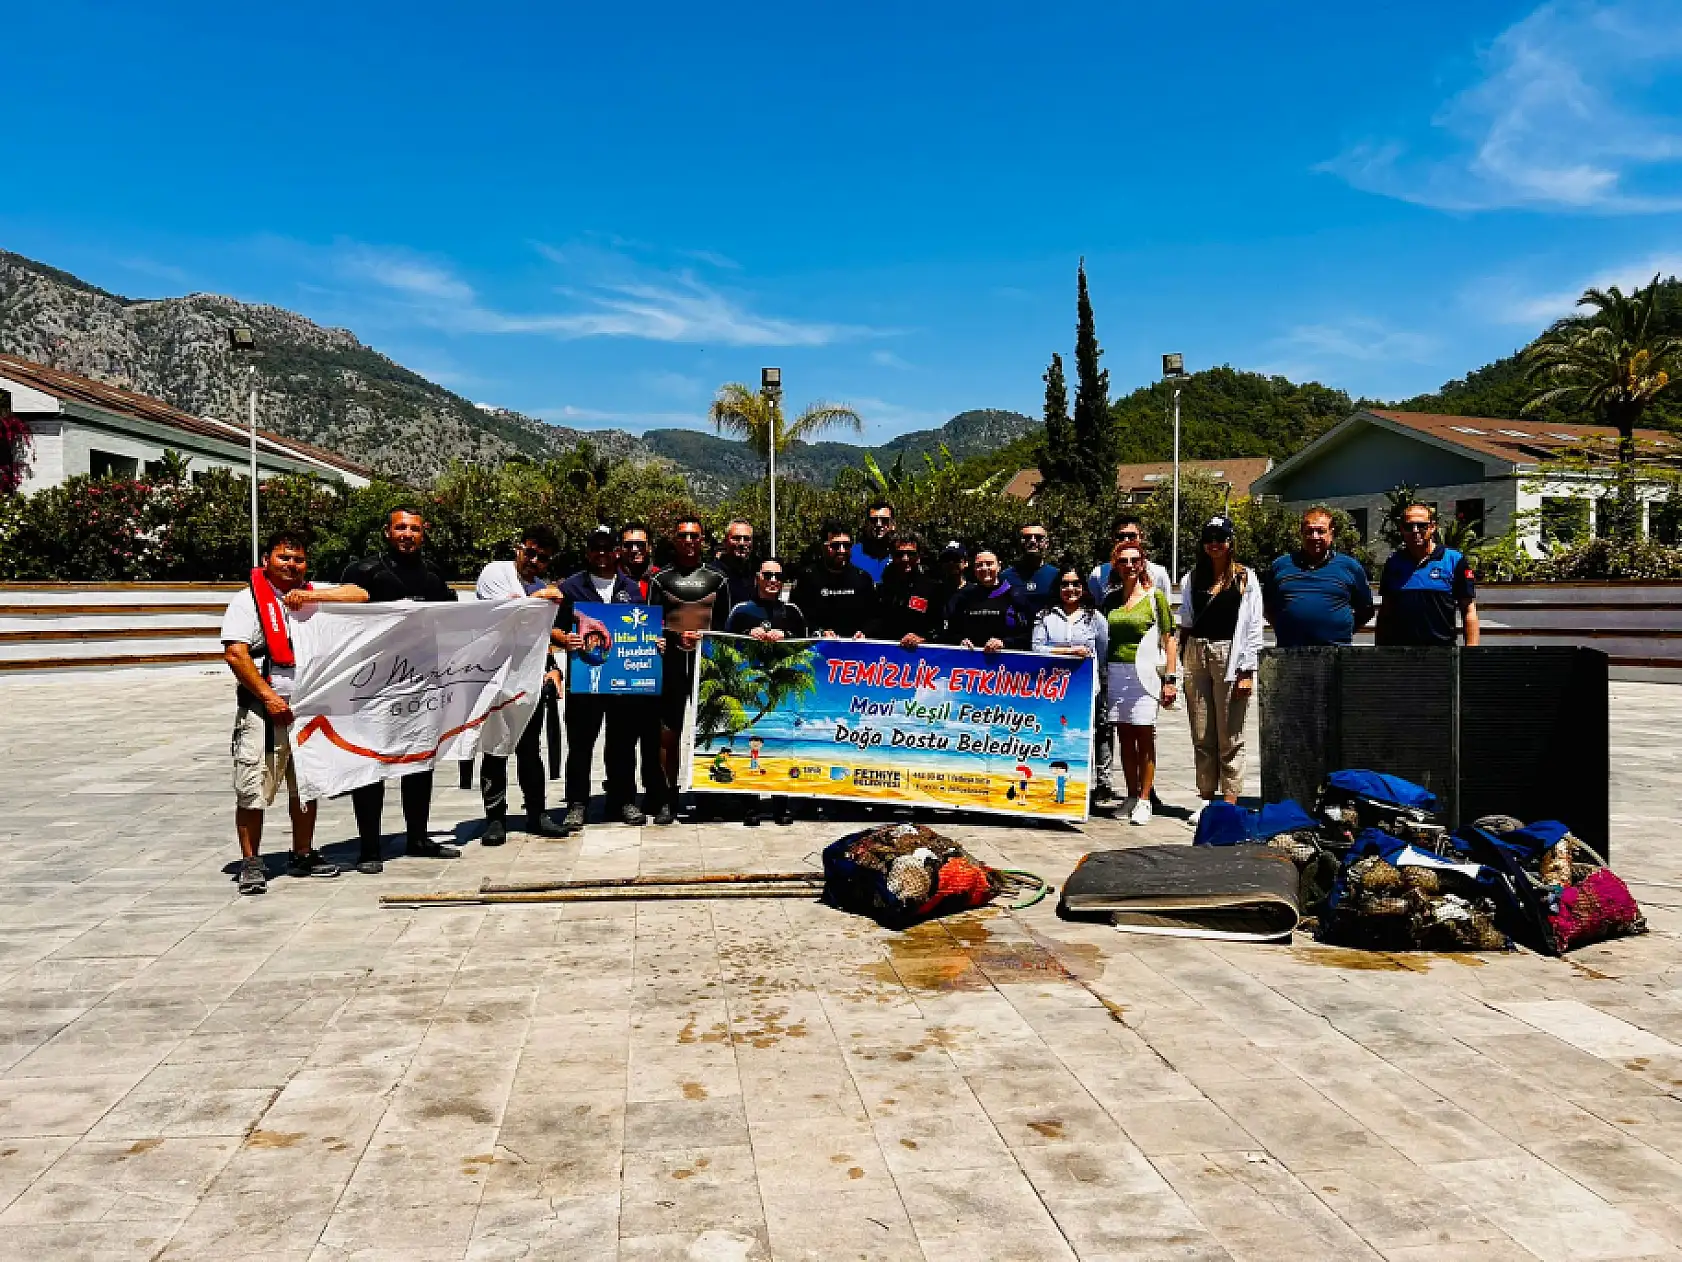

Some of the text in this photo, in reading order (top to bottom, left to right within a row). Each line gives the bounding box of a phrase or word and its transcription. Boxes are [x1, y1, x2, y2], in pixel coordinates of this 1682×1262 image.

[827, 656, 1072, 702] TEMİZLİK ETKİNLİĞİ
[850, 696, 1042, 734] Mavi Yeşil Fethiye,
[835, 724, 1052, 762] Doğa Dostu Belediye!
